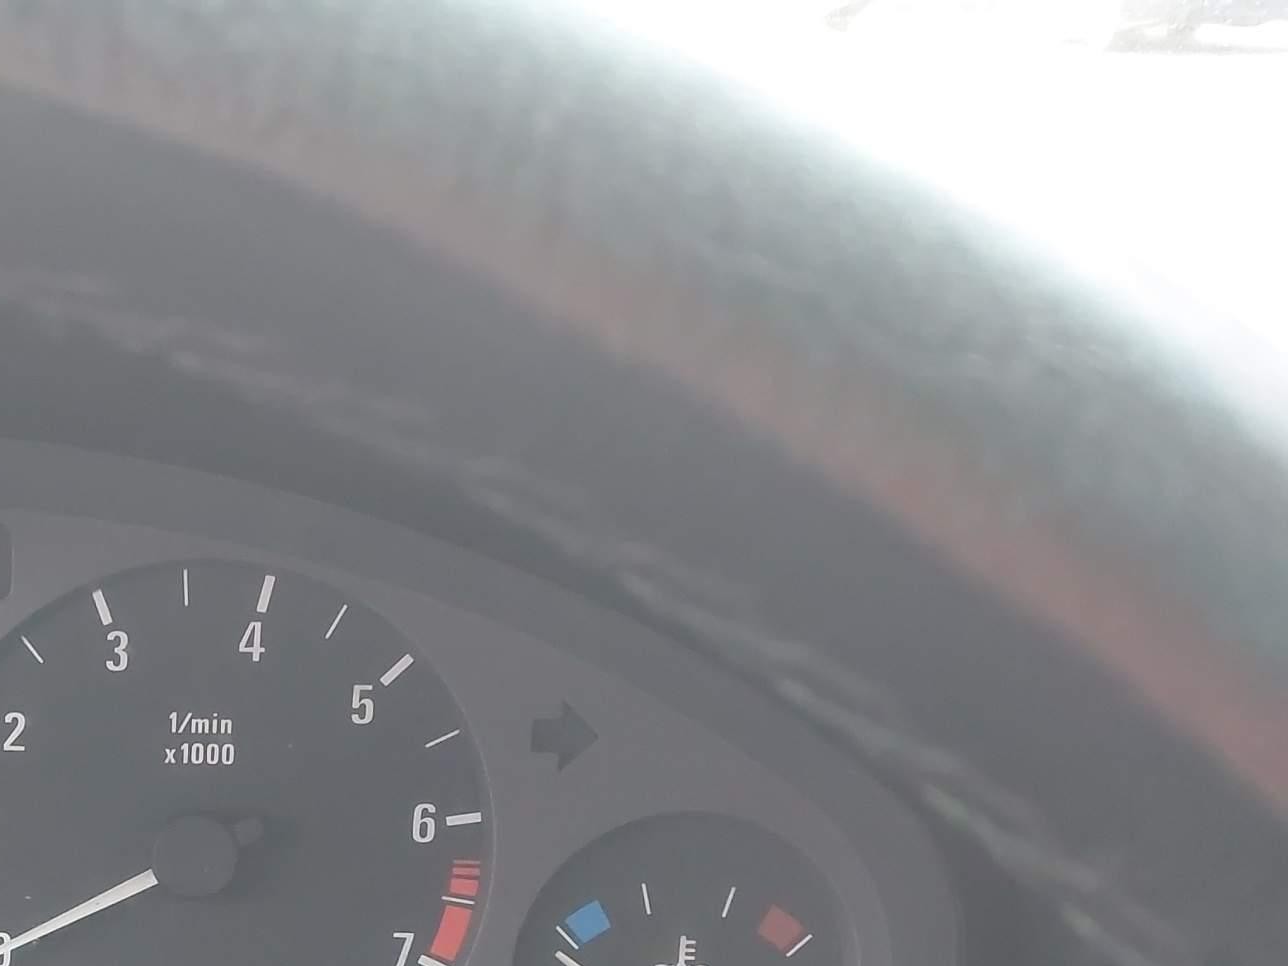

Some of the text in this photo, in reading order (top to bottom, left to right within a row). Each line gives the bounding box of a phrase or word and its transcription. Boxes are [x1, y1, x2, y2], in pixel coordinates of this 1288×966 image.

[105, 630, 129, 672] 3
[238, 621, 266, 662] 4
[169, 711, 233, 734] 1/min
[351, 684, 374, 725] 5
[3, 712, 26, 751] 2
[412, 803, 436, 843] 6
